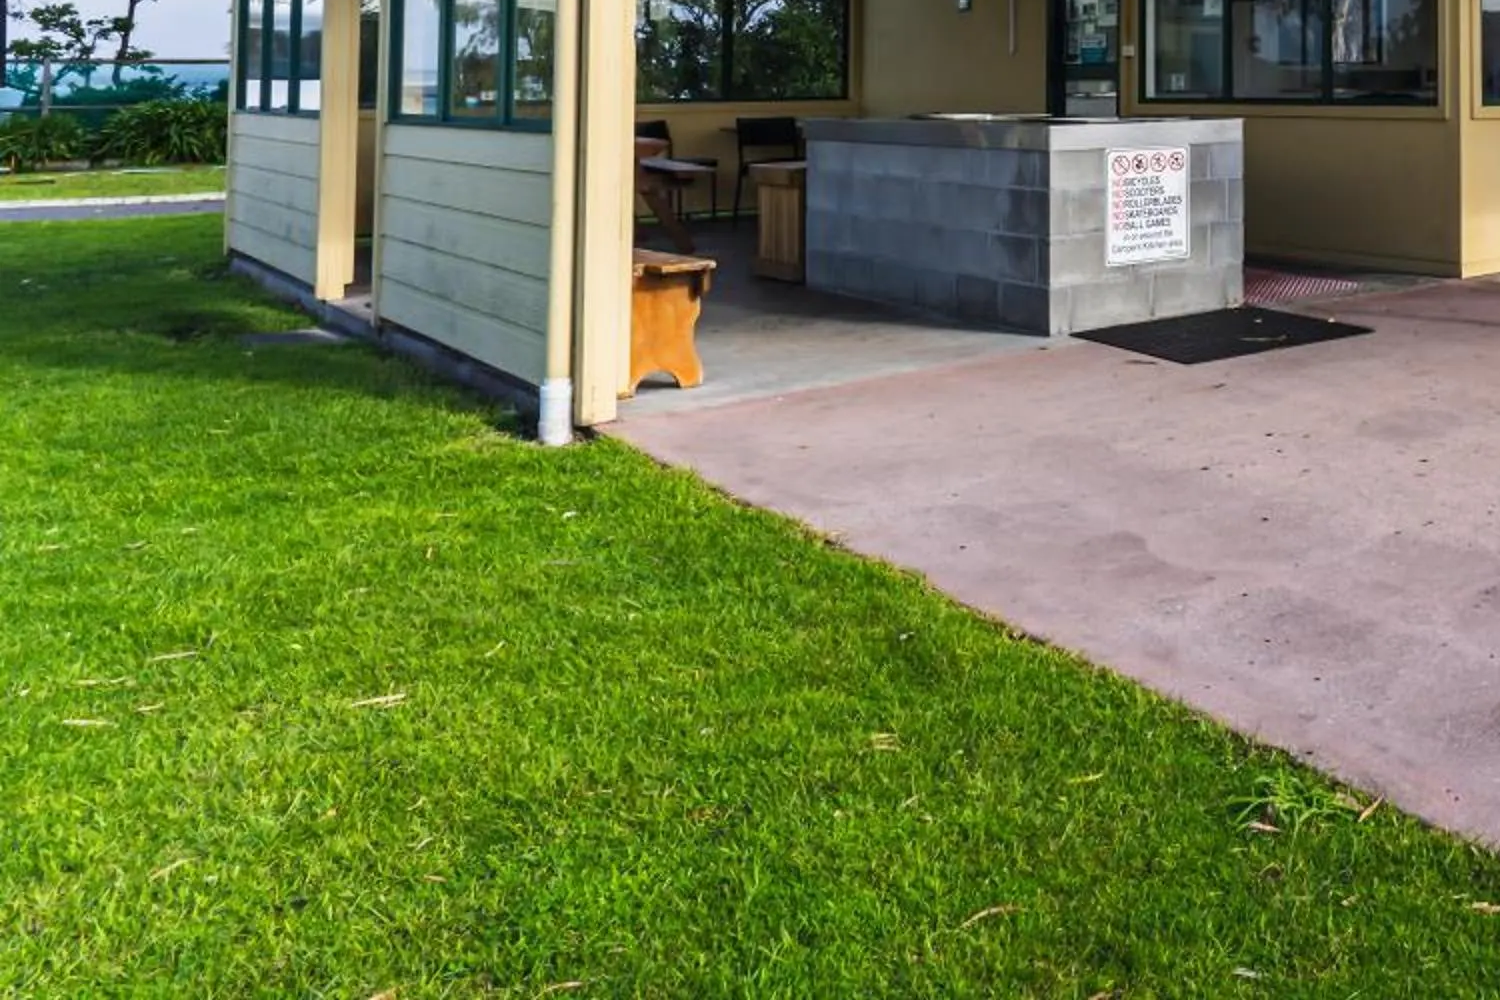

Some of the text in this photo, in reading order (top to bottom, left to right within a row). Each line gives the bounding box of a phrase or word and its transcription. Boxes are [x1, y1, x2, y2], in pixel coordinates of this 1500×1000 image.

[1123, 195, 1182, 208] ROLLERBLADES
[1125, 206, 1178, 219] SKATEBOARDS
[1146, 217, 1171, 228] GAMES
